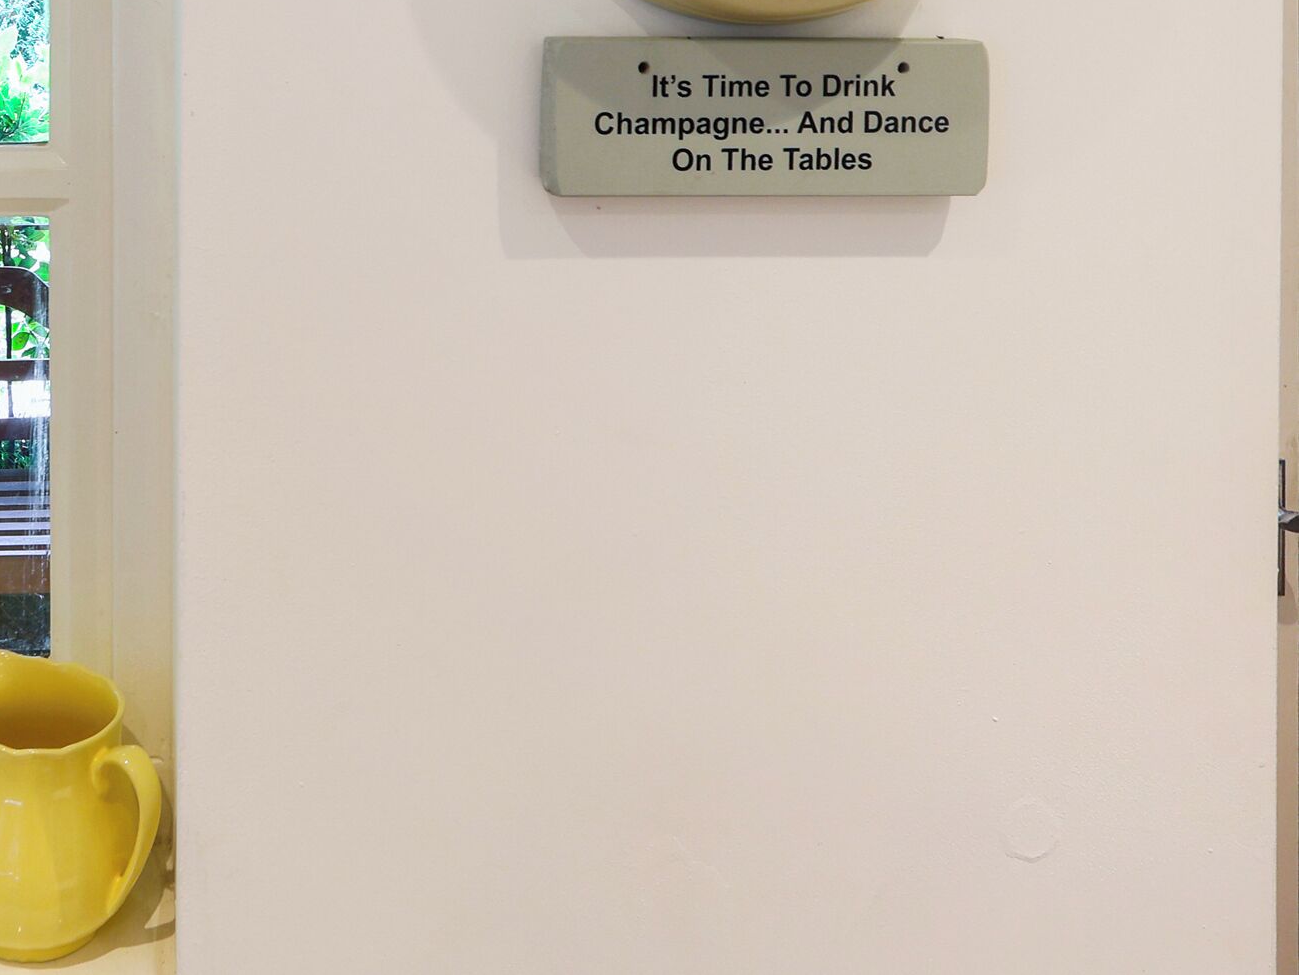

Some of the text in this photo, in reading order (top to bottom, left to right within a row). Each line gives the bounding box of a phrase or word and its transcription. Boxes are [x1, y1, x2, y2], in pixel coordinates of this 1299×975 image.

[651, 73, 896, 98] It’s Time To Drink
[594, 110, 949, 140] Champagne... And Dance
[672, 147, 872, 171] On The Tables
